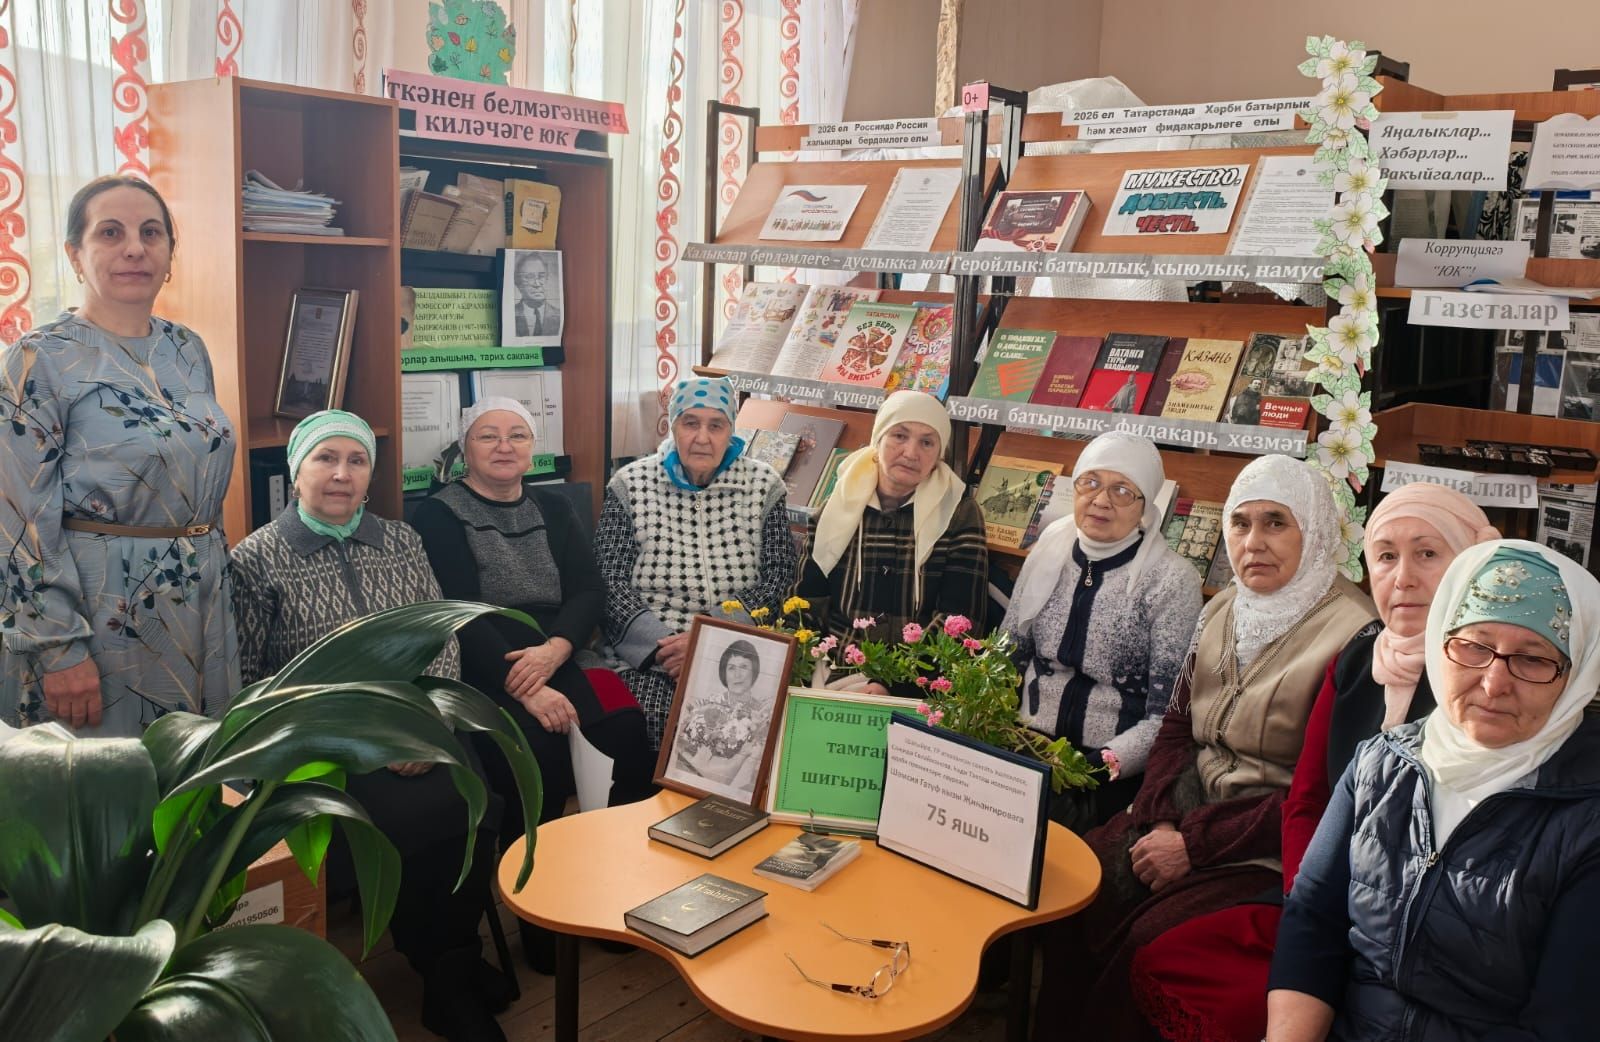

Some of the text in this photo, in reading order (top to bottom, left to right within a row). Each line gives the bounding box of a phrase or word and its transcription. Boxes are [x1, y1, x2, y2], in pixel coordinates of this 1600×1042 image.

[383, 73, 626, 131] ткәнен белмәгәннең
[965, 92, 979, 105] 0+
[1073, 99, 1311, 121] 2026 ел Татарстанда Хәрби батырлык
[425, 115, 569, 147] киләчәге юк
[818, 121, 928, 134] 2026 ел Россиядә Россия
[1109, 125, 1148, 135] хезмәт
[1155, 119, 1243, 134] фидакарьлеге
[1253, 117, 1280, 127] елы
[1381, 124, 1491, 141] Яңалыклар...
[806, 134, 929, 147] халыклары бердәмлеге елы
[1379, 147, 1468, 163] Хәбәрләр...
[1124, 168, 1241, 190] МУЖЕСТВО.
[1379, 167, 1495, 183] Вакыйгалар...
[1118, 191, 1228, 215] ДОБЛЕСТЬ.
[1135, 215, 1199, 232] ЧЕСТЬ.
[1424, 242, 1503, 257] Коррупциягә
[750, 249, 830, 268] бердәмлеге
[843, 254, 917, 272] дуслыкка
[920, 254, 950, 271] юл!
[952, 256, 1324, 282] Геройлык: батырлык, кыюлык, намус
[1423, 295, 1559, 326] Газеталар
[400, 354, 427, 365] орлар
[480, 353, 505, 362] тарих
[506, 352, 539, 360] саклана
[1109, 348, 1144, 358] ВАТАНГА
[1184, 350, 1232, 364] КАЗАНЬ
[773, 383, 825, 401] дуслык
[834, 388, 883, 409] күпере
[1261, 411, 1289, 419] люди
[1264, 402, 1303, 413] Вечные
[948, 400, 1306, 453] Хәрби батырлык- фидакарь хезмәт
[811, 705, 891, 731] Кояш ну
[826, 741, 887, 760] тамга
[926, 803, 990, 843] 75 яшь
